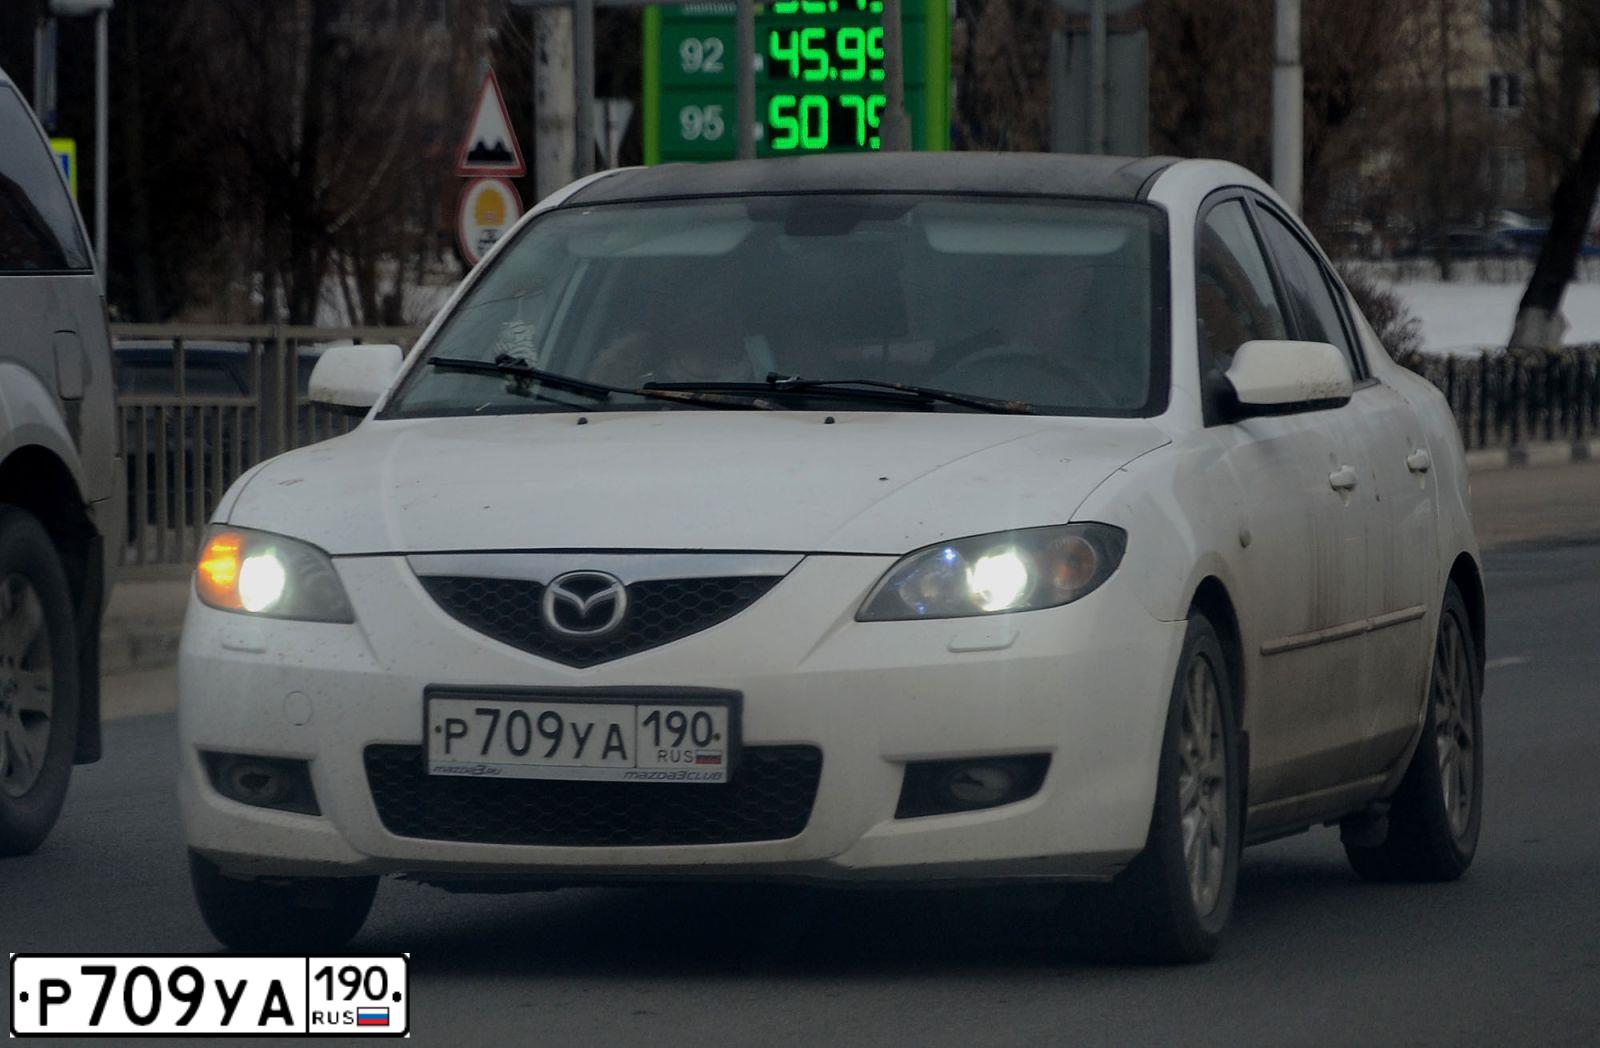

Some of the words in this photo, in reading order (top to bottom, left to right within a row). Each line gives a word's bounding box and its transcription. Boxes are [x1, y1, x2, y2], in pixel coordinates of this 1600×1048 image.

[679, 37, 725, 73] 92
[679, 105, 725, 141] 95
[642, 710, 713, 747] 190
[657, 751, 694, 763] RUS
